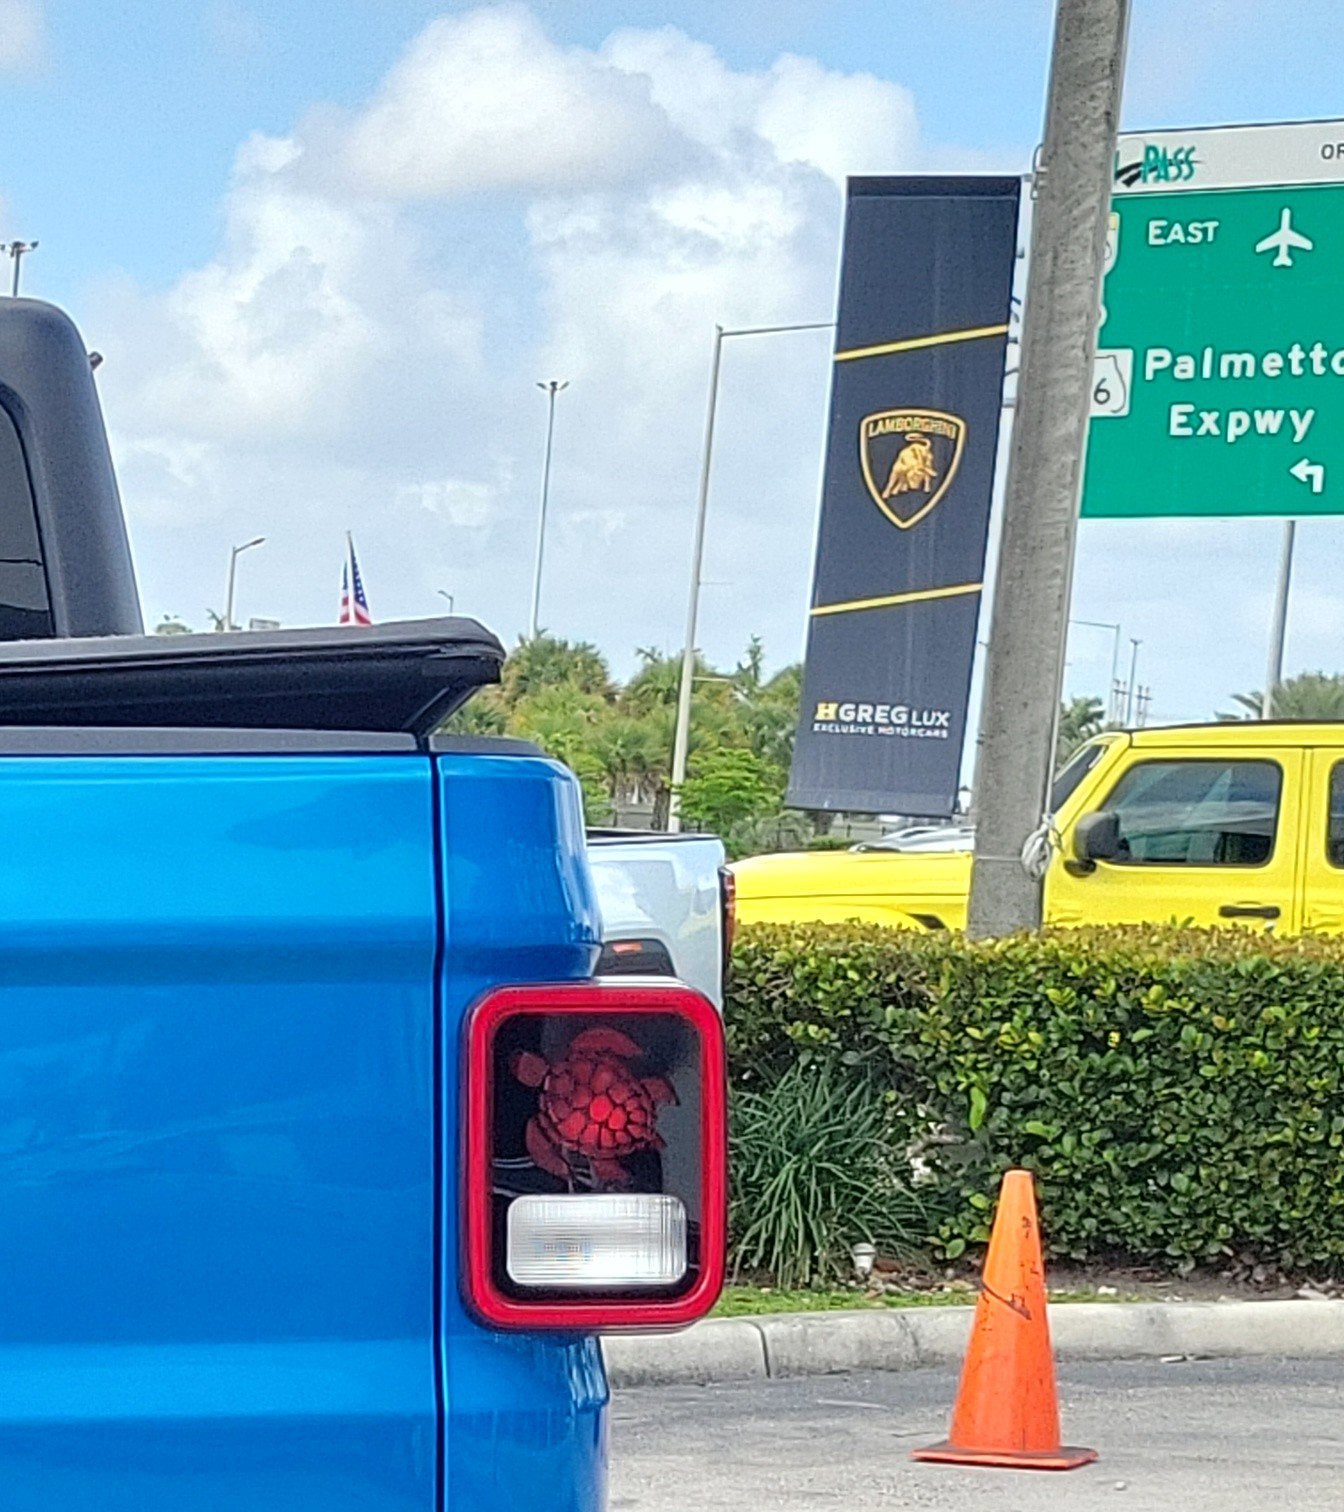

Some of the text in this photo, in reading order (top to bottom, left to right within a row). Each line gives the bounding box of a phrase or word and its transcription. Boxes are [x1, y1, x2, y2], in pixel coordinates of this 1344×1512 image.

[1148, 219, 1220, 246] EAST
[1169, 404, 1316, 443] Expwy
[911, 710, 951, 727] LUX
[813, 723, 948, 739] EXCLUSIVE MOTORCARS
